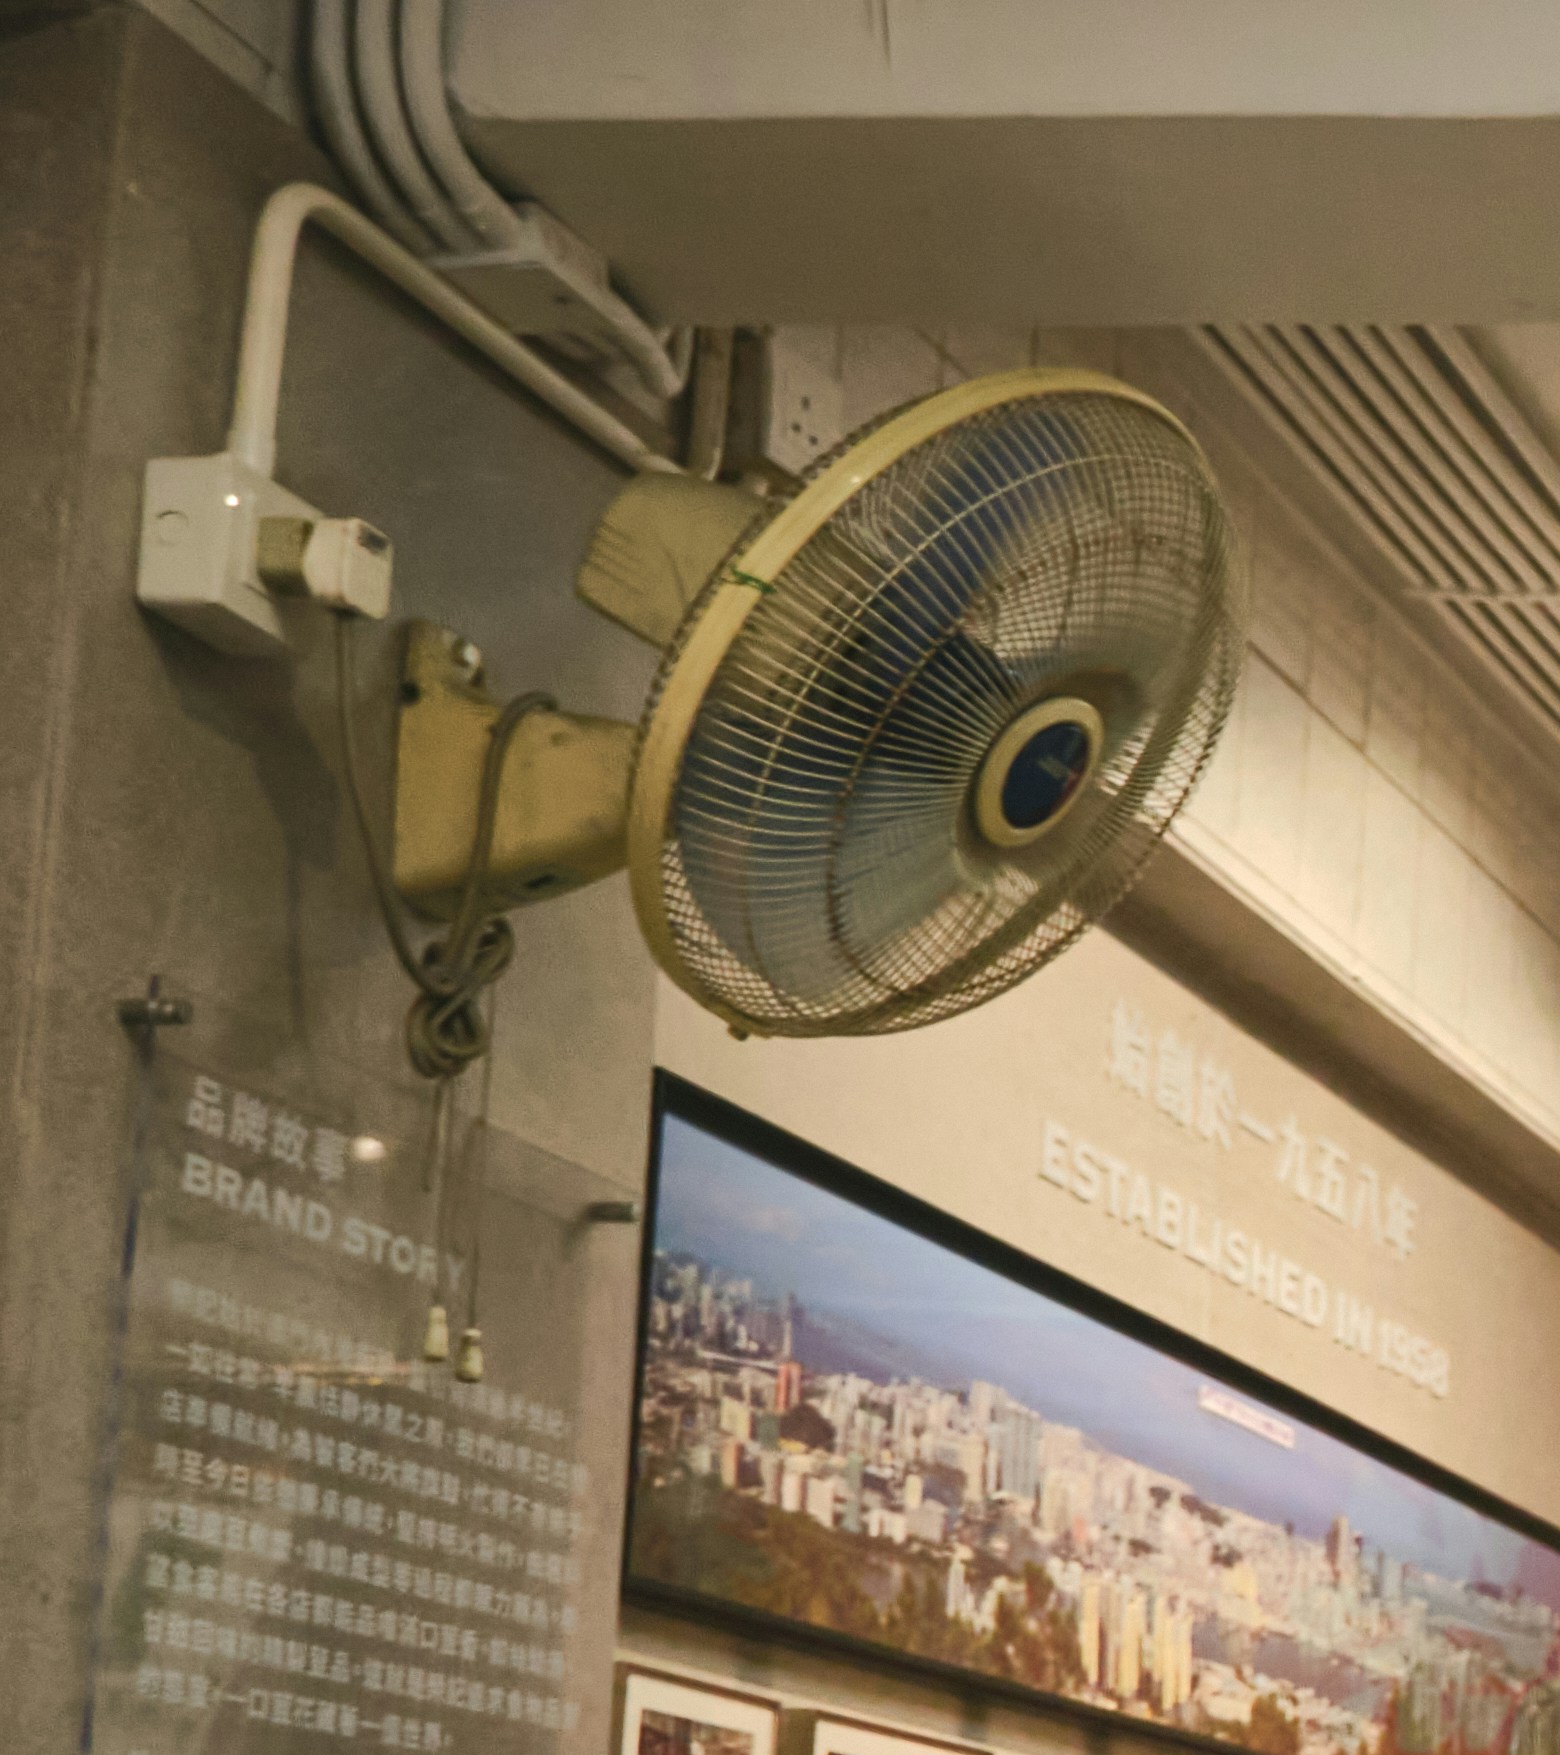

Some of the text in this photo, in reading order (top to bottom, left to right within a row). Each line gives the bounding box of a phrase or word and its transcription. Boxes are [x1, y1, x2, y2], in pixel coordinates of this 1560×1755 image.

[180, 1152, 468, 1291] BRAND STORY
[186, 1075, 347, 1186] 品牌故事
[1106, 1003, 1420, 1261] 始創於一九五八年
[1040, 1119, 1451, 1400] ESTABLISHED IN 1958
